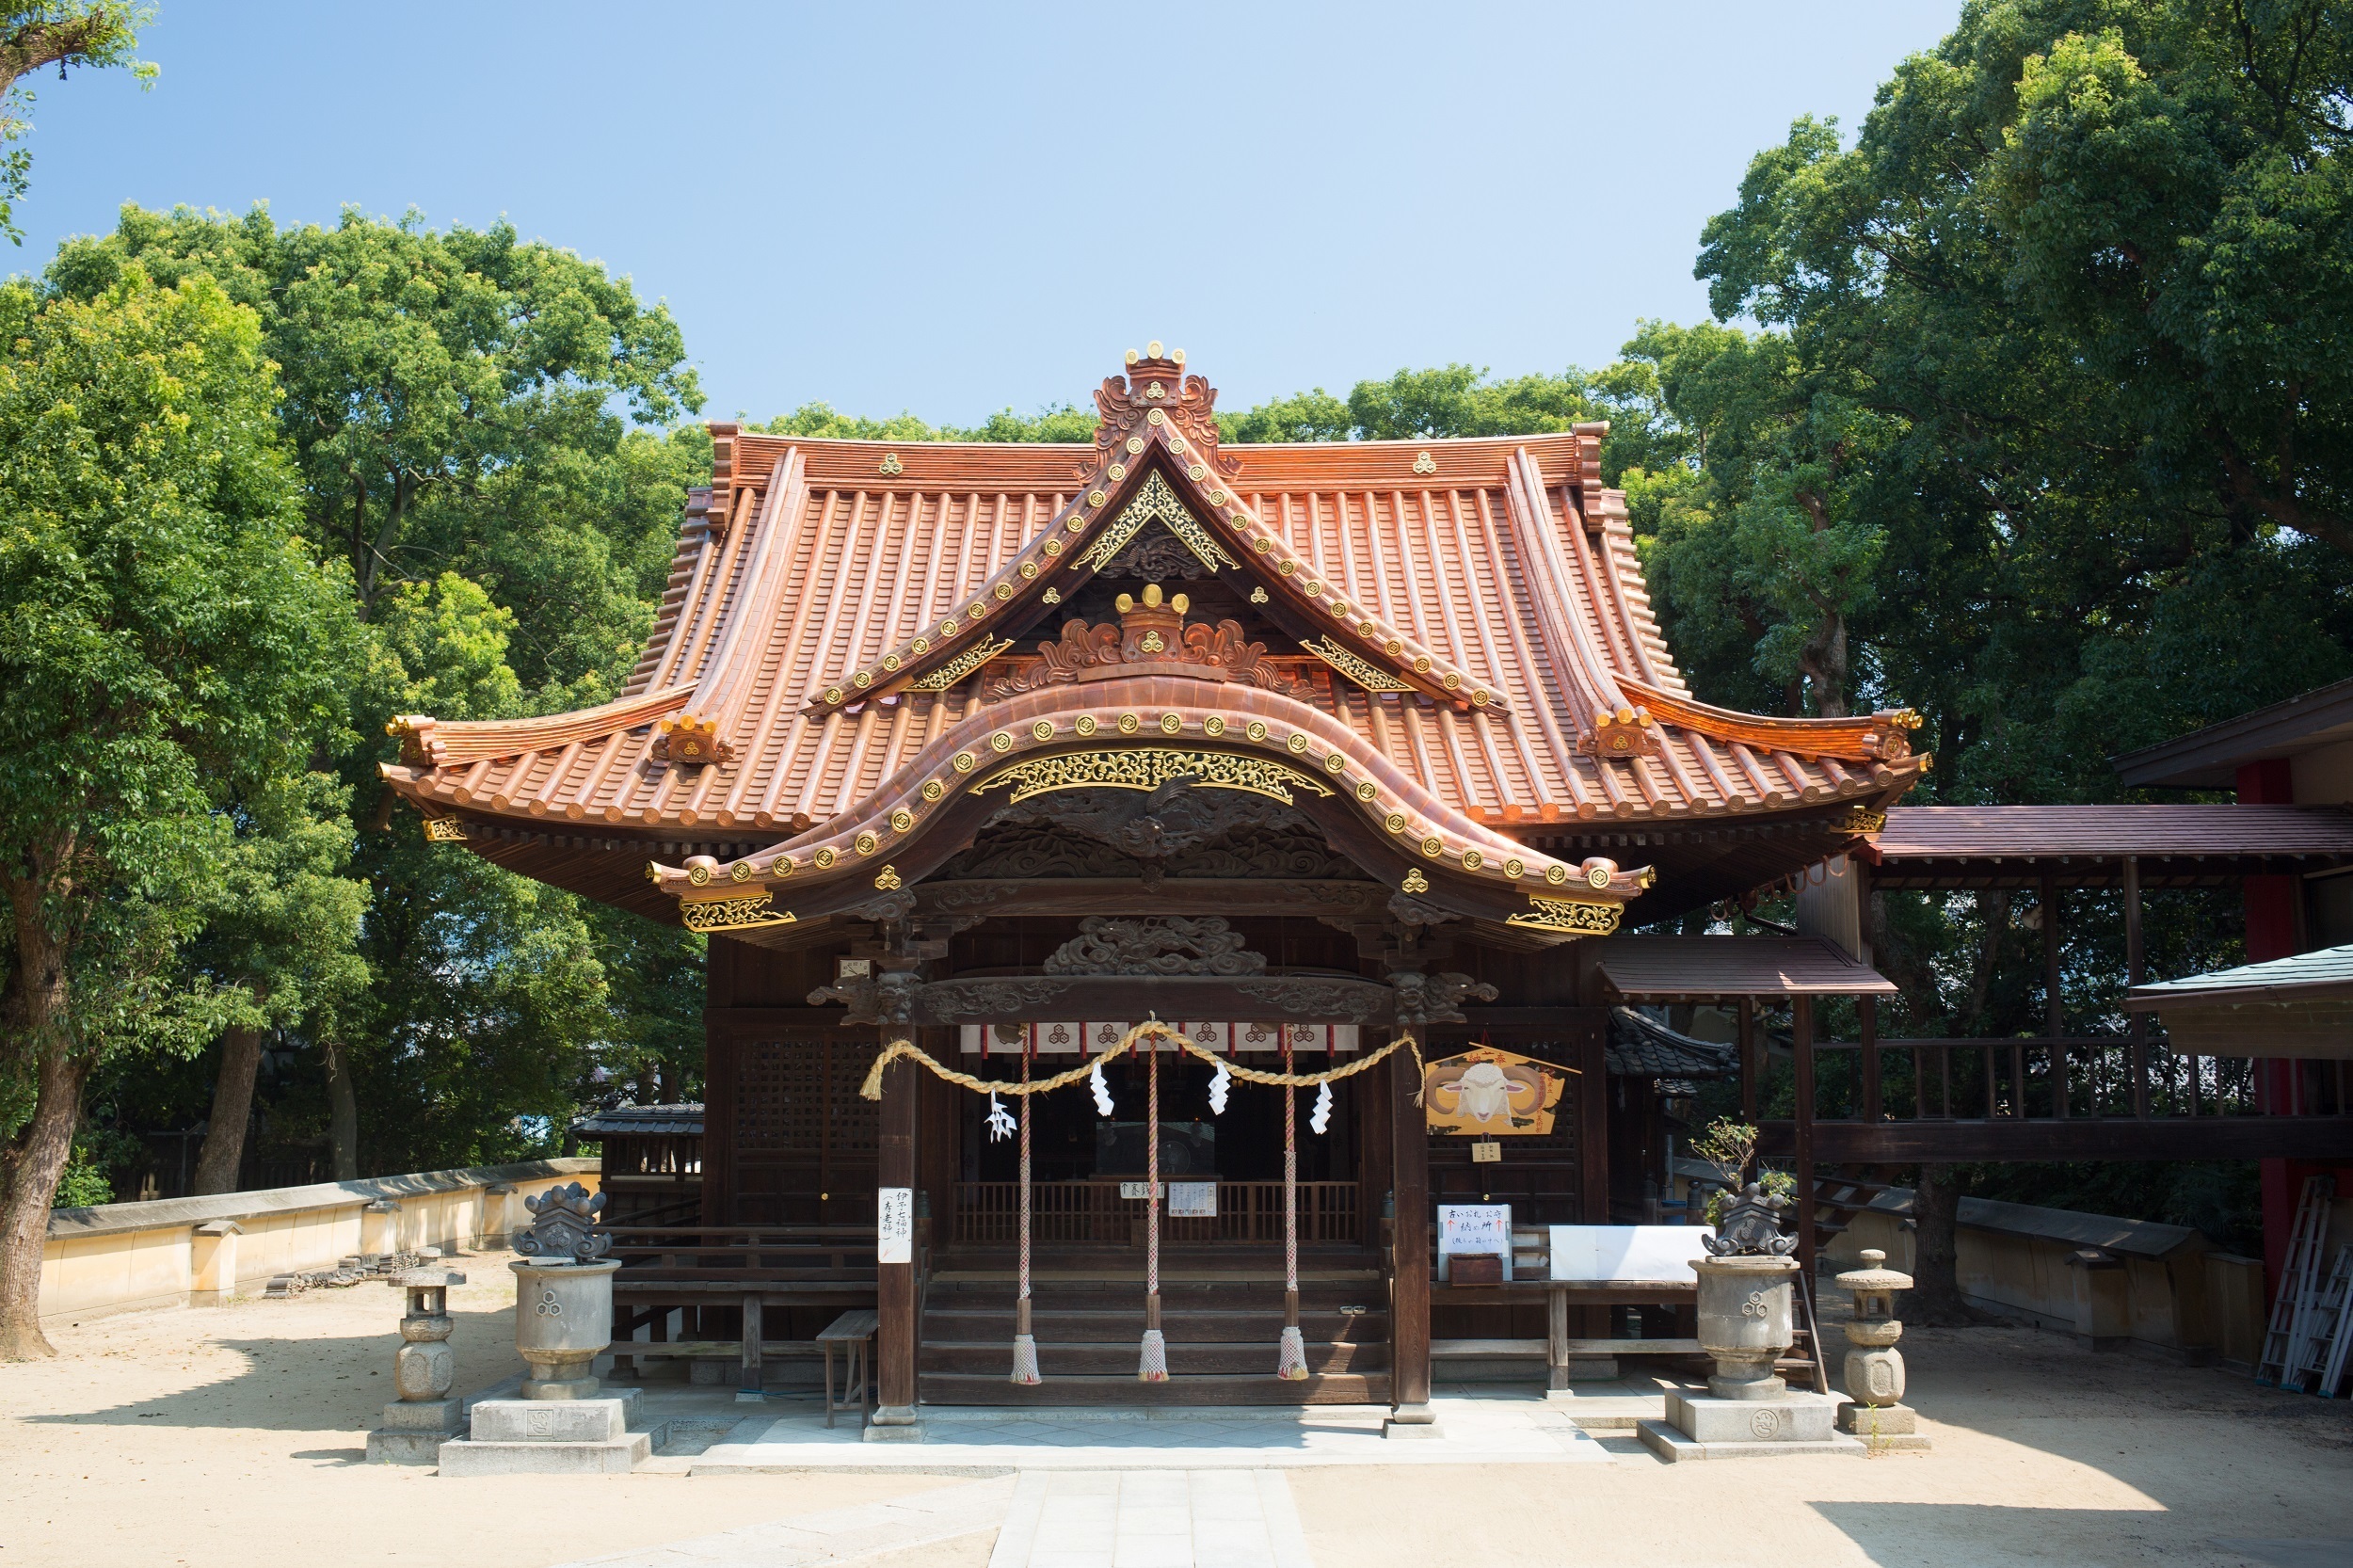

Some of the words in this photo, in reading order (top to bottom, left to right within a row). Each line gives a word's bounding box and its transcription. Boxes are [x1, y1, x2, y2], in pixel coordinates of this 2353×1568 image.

[896, 1192, 909, 1239] 伊予七福神
